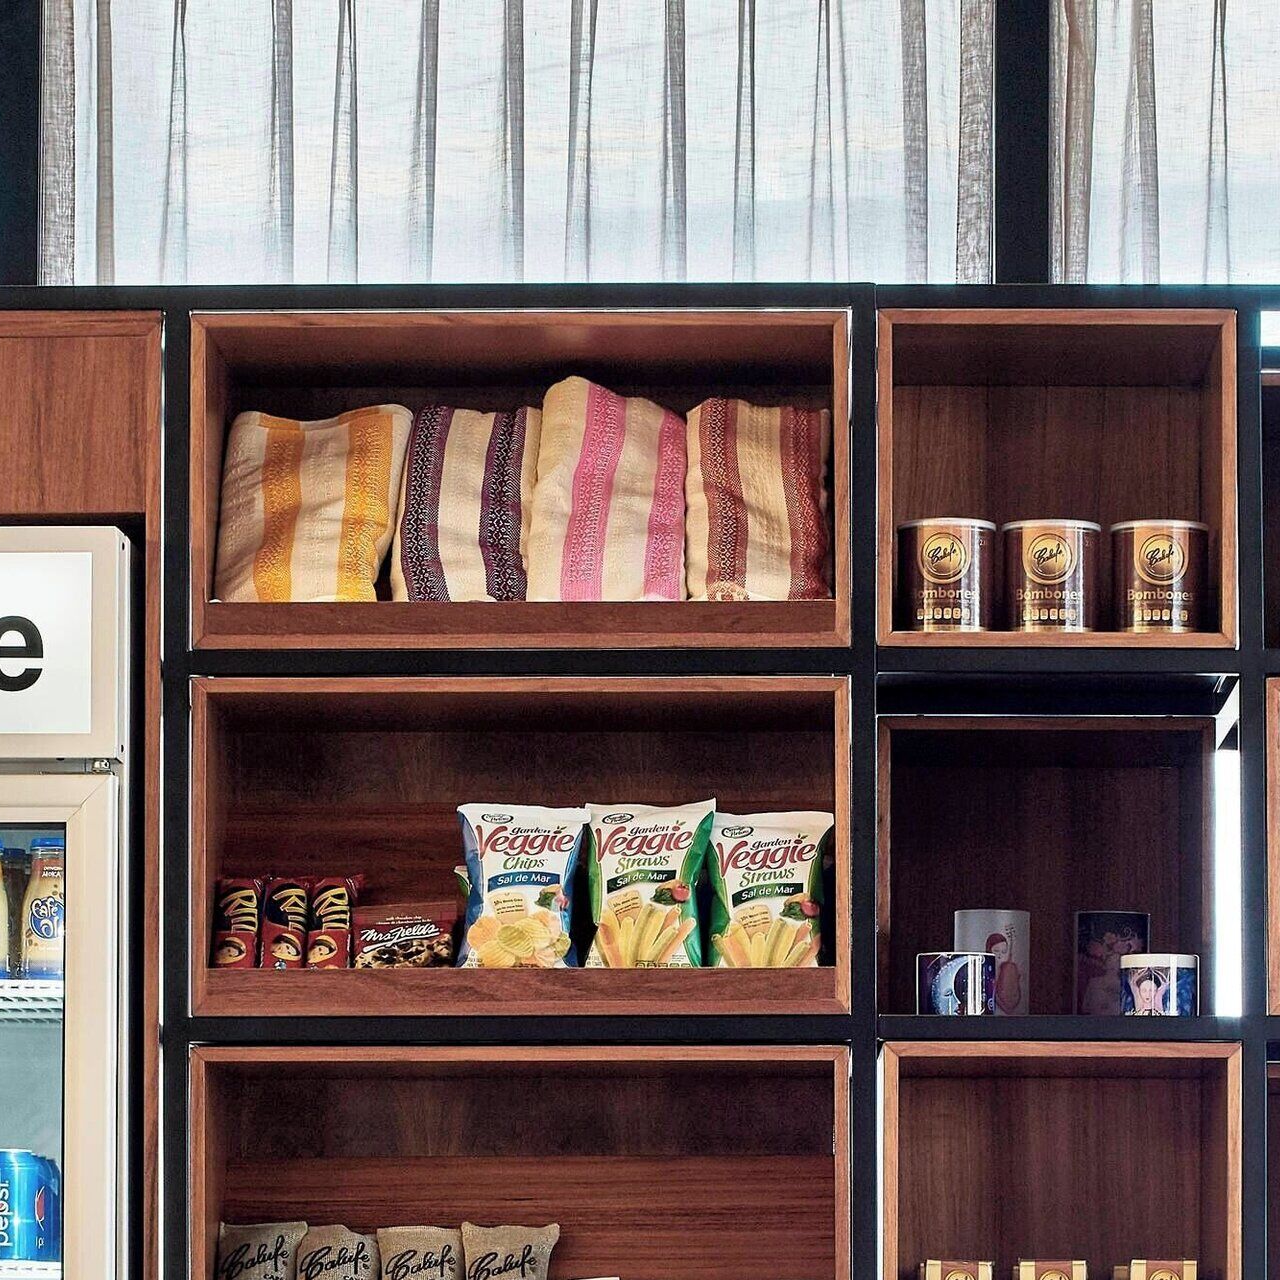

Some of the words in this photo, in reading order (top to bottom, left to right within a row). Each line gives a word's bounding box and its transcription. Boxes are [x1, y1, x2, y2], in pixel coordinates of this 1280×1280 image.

[510, 826, 552, 835] garden
[630, 824, 670, 836] garden
[475, 824, 575, 861] Veggie
[595, 825, 693, 862] Veggie
[751, 838, 792, 850] garden
[503, 856, 545, 870] Chips
[615, 855, 670, 875] Straws
[716, 840, 817, 878] Veggie
[497, 876, 513, 885] Sal
[515, 874, 529, 882] de
[531, 874, 551, 883] Mar
[616, 876, 631, 887] Sal
[633, 872, 645, 881] de
[647, 872, 668, 881] Mar
[739, 867, 795, 888] Straws
[741, 889, 756, 900] Sal
[759, 887, 771, 895] de
[774, 886, 795, 895] Mar
